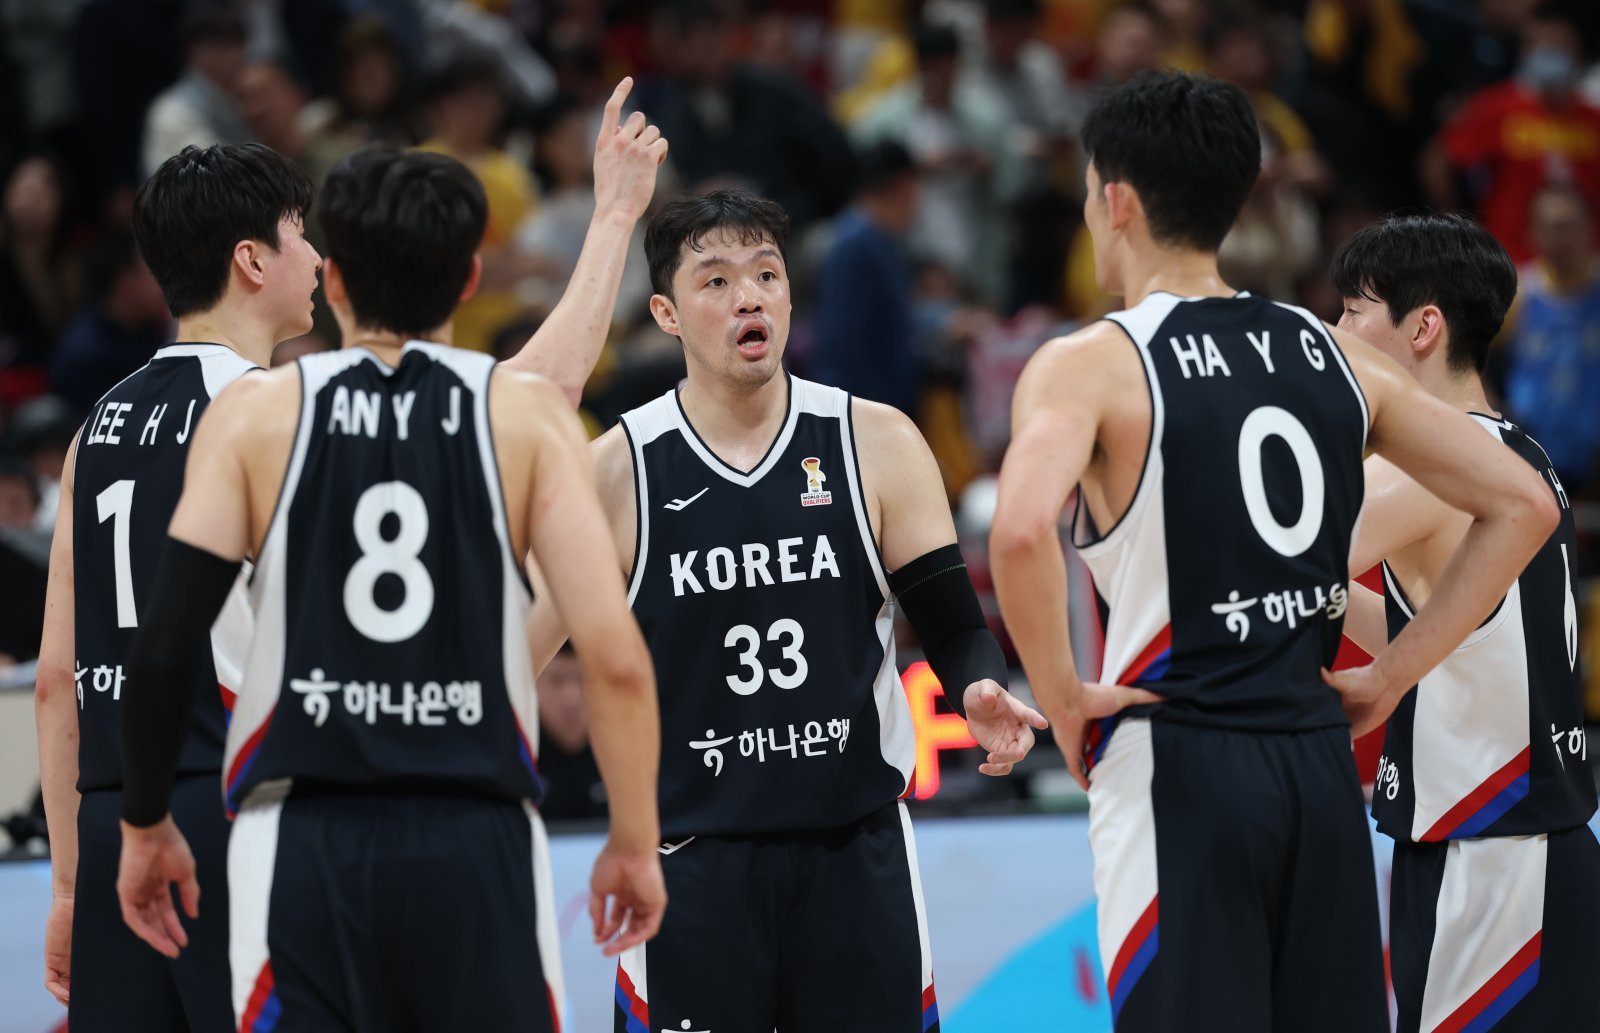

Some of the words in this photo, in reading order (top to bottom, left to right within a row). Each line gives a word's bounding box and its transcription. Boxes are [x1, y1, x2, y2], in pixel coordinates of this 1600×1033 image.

[1169, 333, 1232, 379] HA
[1246, 330, 1275, 374] Y
[1299, 329, 1326, 372] G
[87, 402, 133, 445] LEE
[139, 403, 168, 445] H
[176, 399, 197, 445] J
[327, 386, 381, 439] AN
[392, 390, 416, 441] Y
[441, 386, 461, 436] J
[1238, 405, 1325, 558] 0
[96, 479, 138, 629] 1
[343, 480, 434, 643] 8
[669, 534, 841, 597] KOREA
[723, 618, 809, 696] 33
[343, 680, 483, 726] 하나은행
[738, 718, 850, 763] 하나은행
